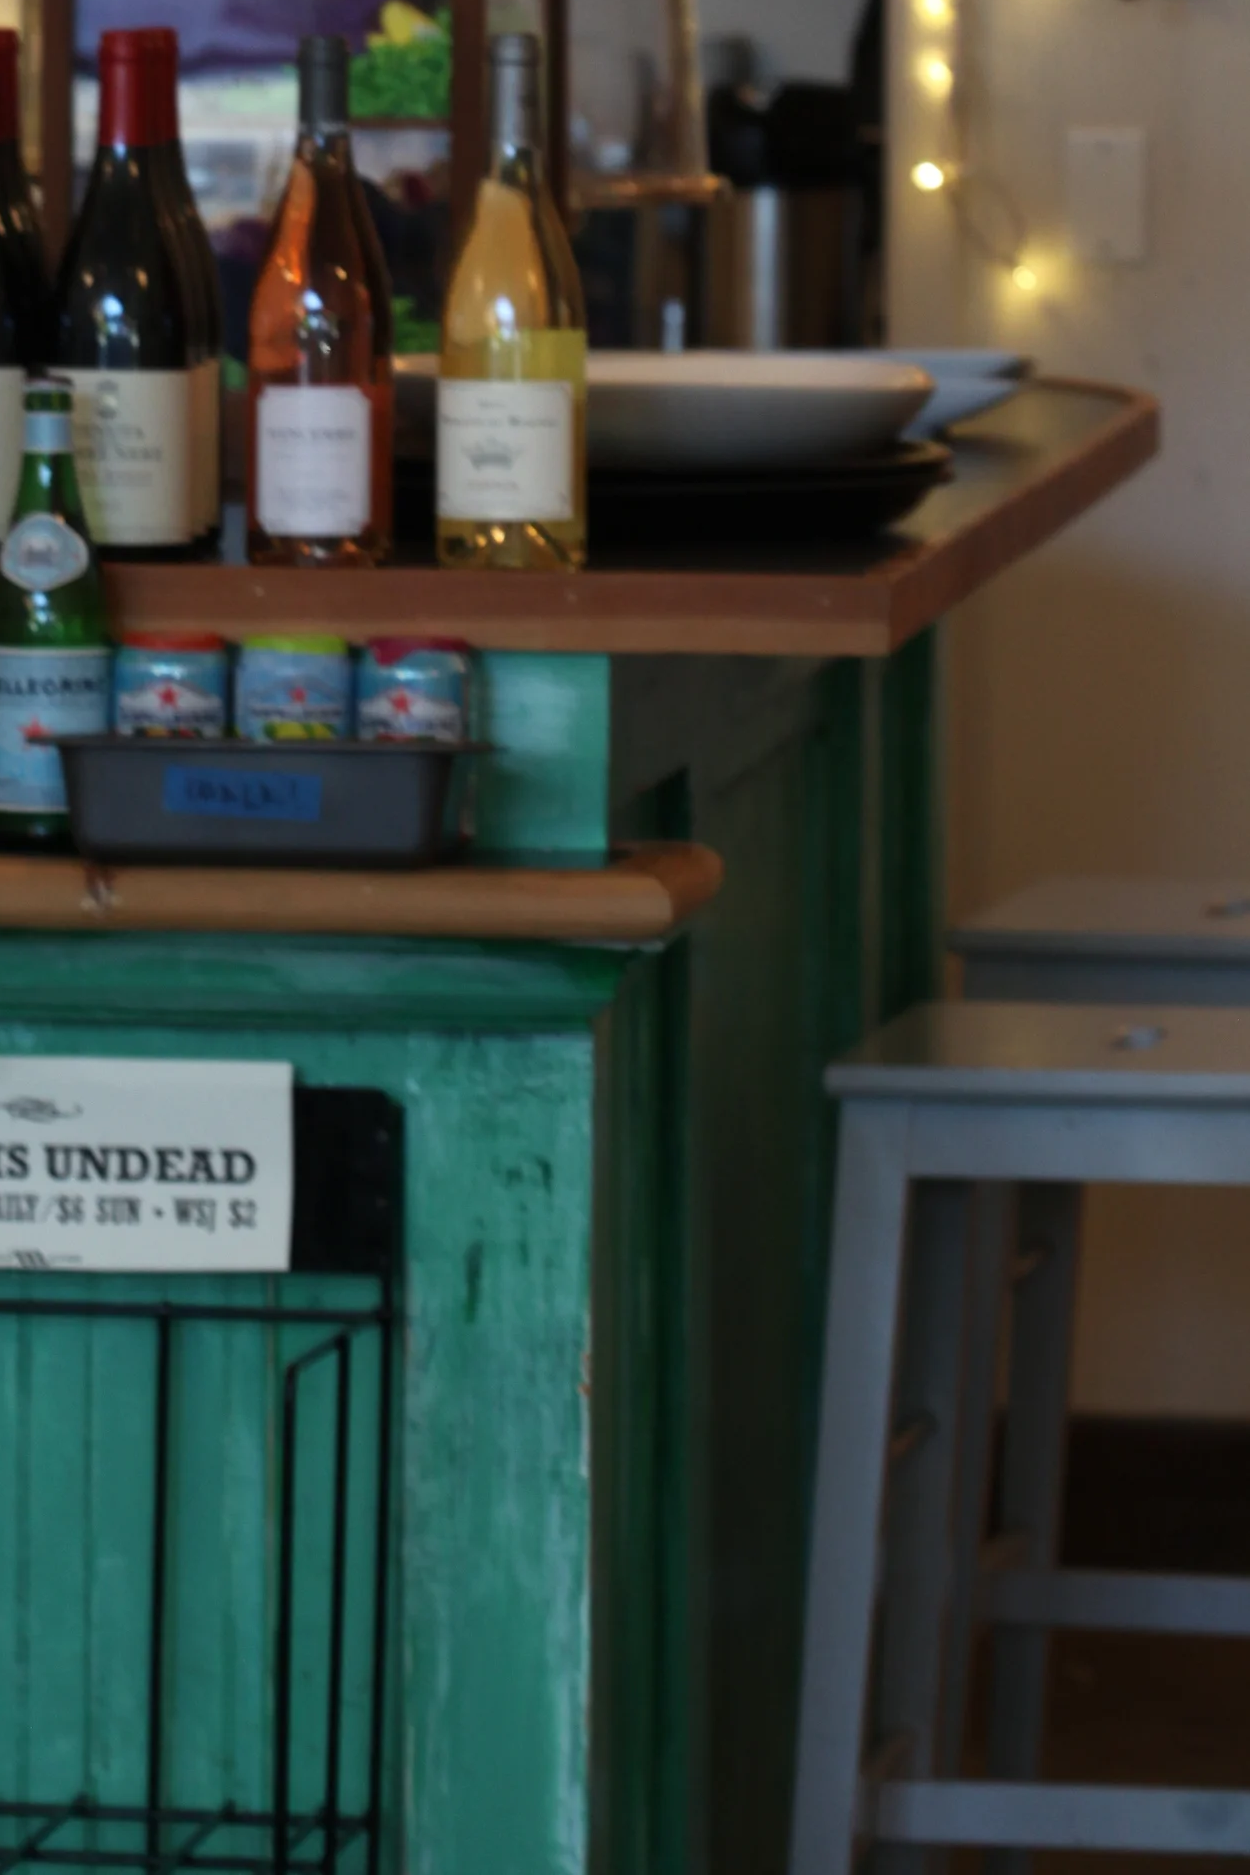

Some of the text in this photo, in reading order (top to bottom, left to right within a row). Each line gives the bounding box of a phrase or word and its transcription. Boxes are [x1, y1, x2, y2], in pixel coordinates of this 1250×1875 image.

[46, 1144, 257, 1186] UNDEAD
[95, 1197, 142, 1225] SUN
[174, 1198, 218, 1233] WSJ
[227, 1198, 259, 1231] $2
